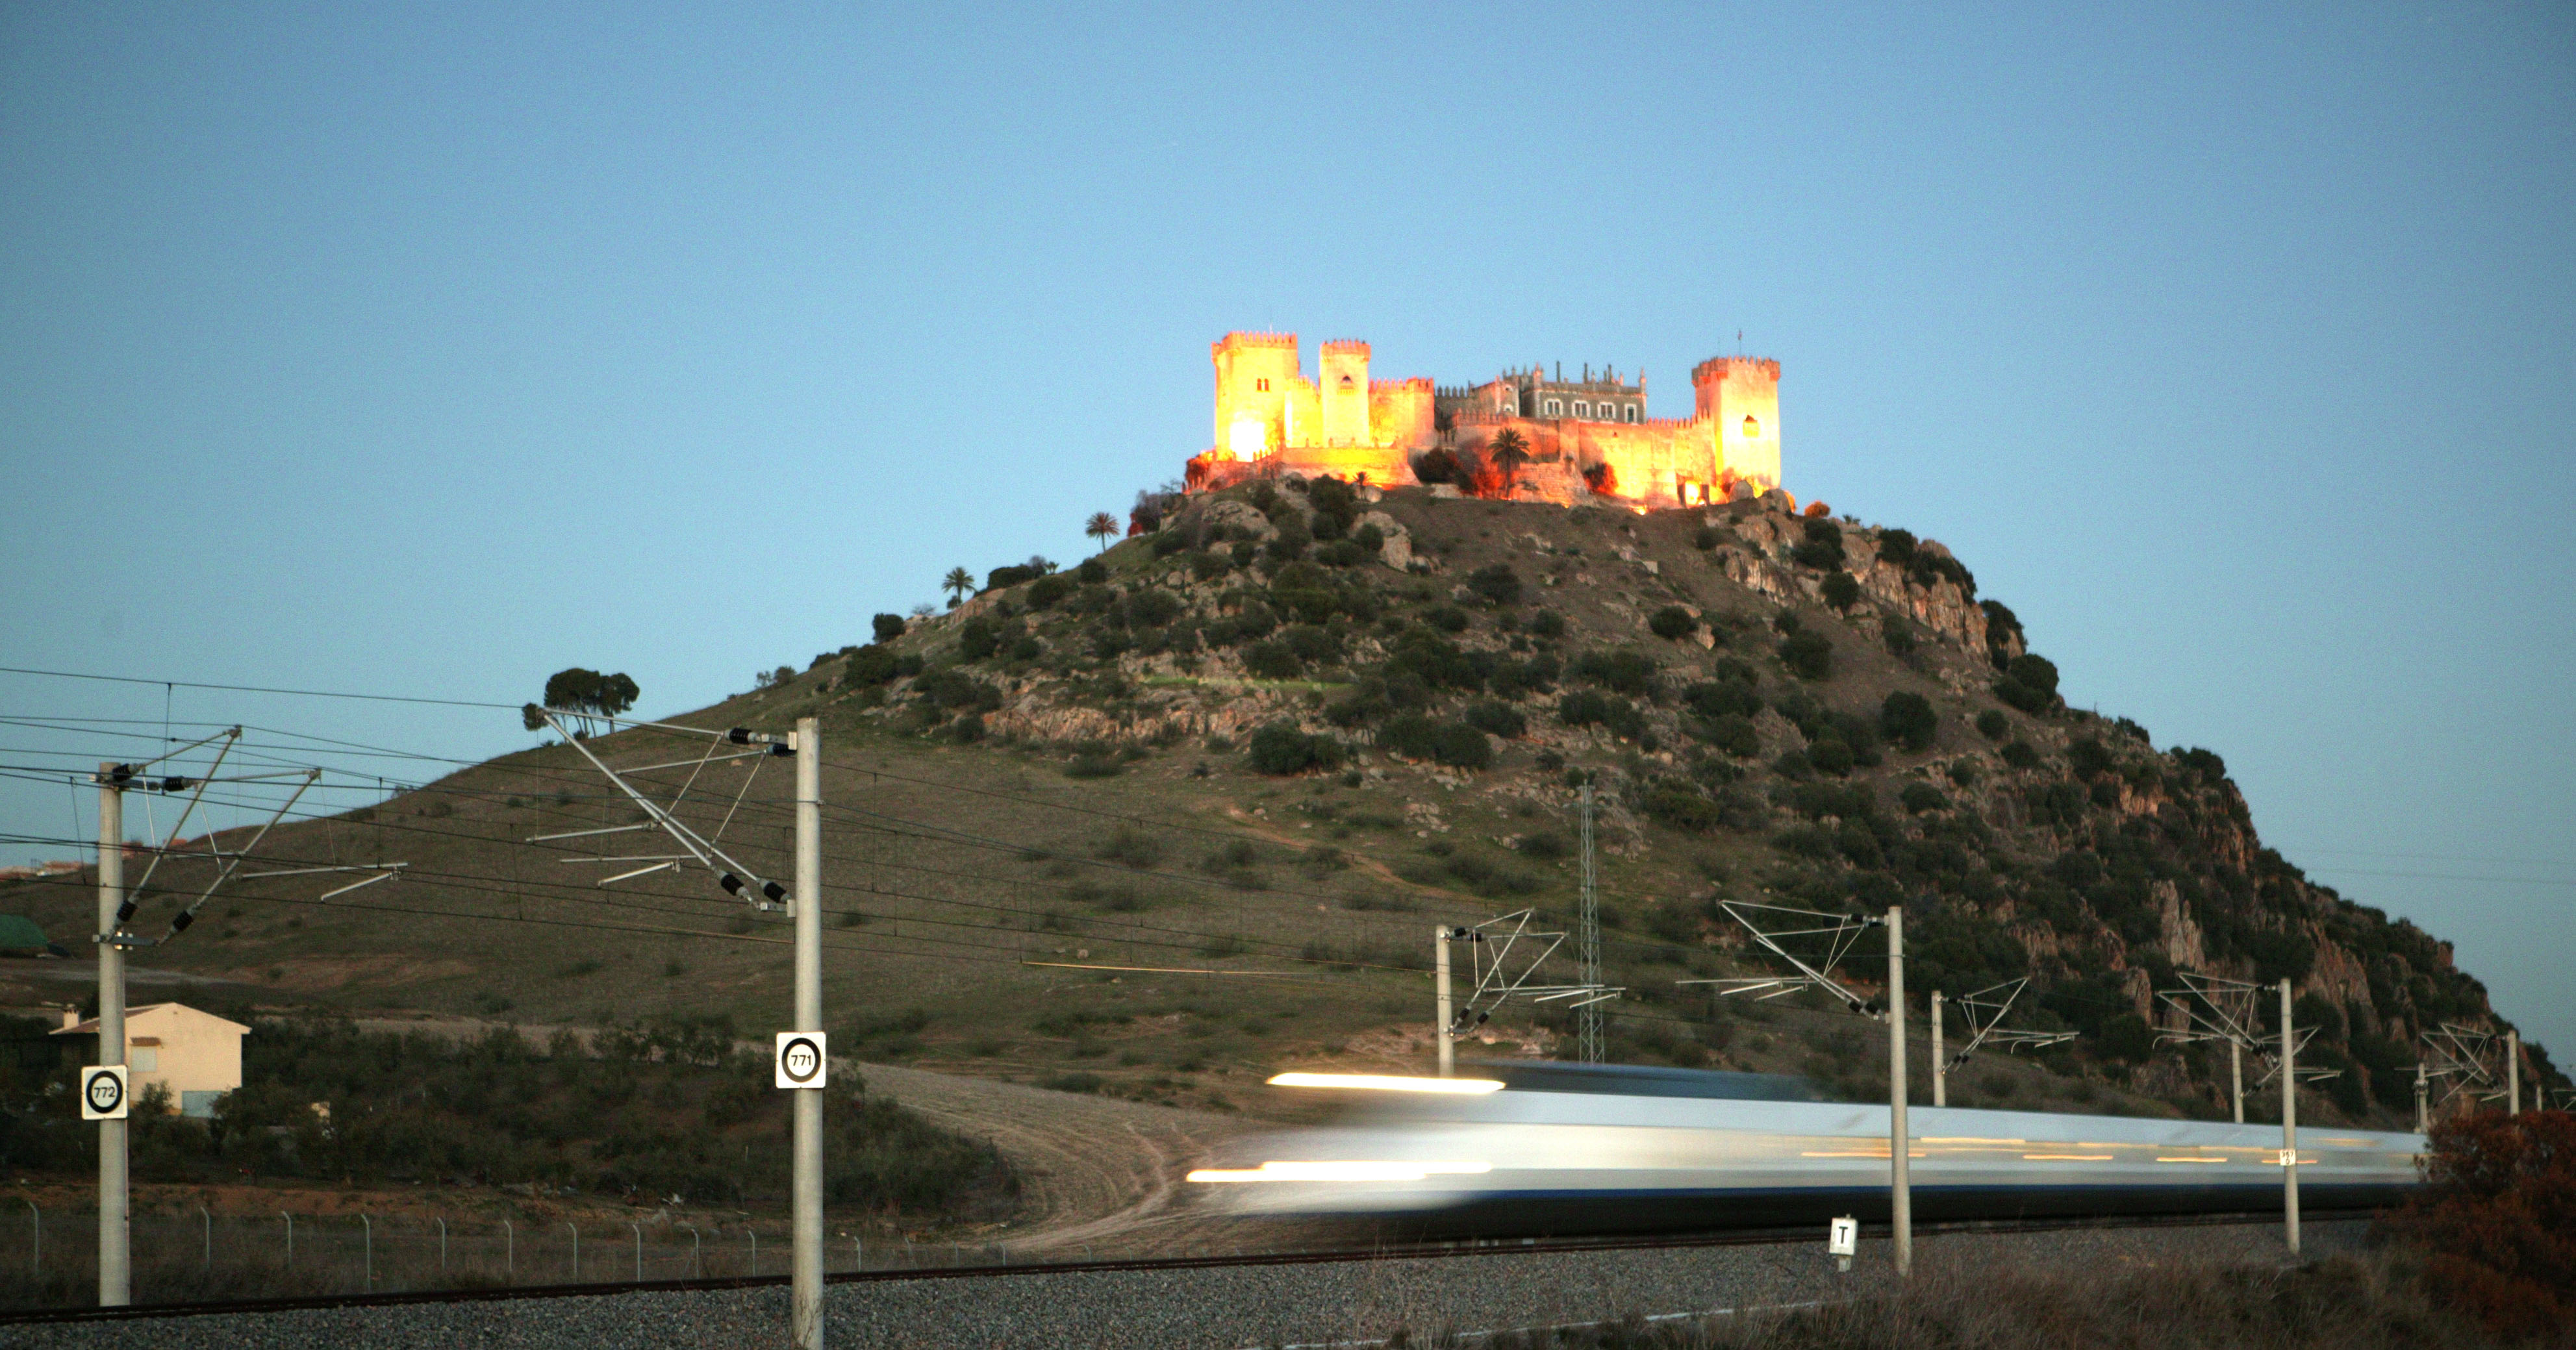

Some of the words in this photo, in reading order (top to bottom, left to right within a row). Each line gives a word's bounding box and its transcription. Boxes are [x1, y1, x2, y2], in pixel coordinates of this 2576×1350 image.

[791, 1055, 811, 1066] 771
[94, 1086, 116, 1098] 772
[1839, 1226, 1849, 1244] T
